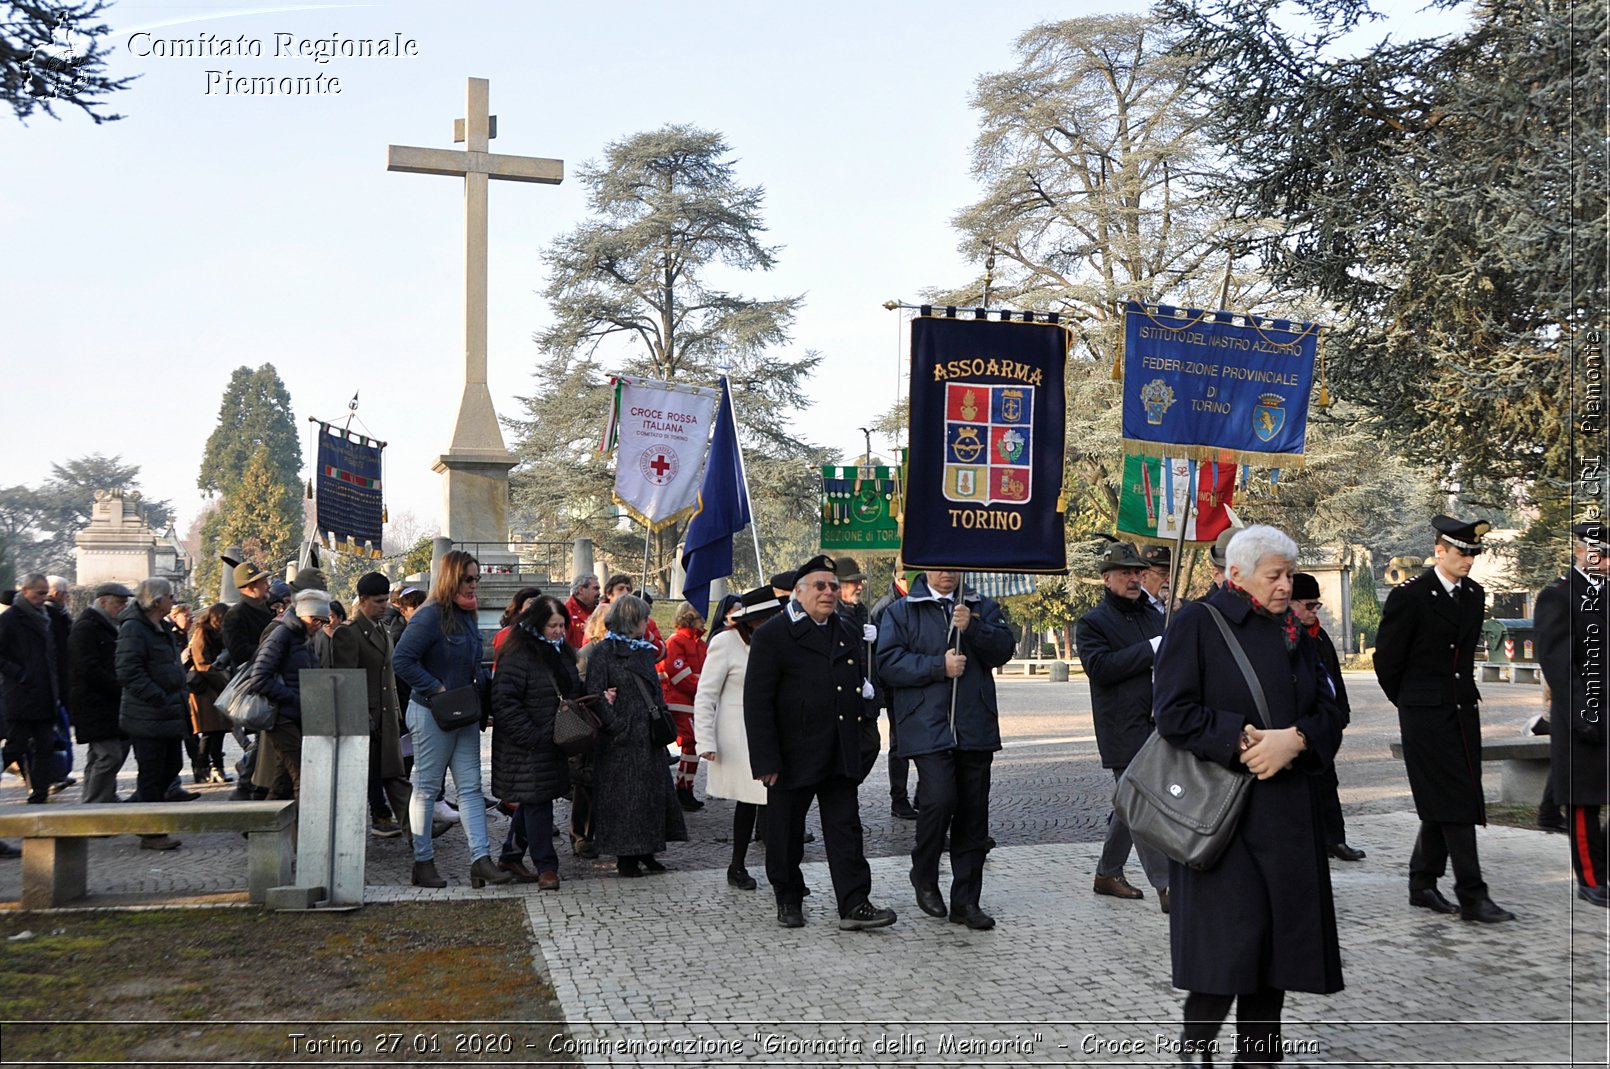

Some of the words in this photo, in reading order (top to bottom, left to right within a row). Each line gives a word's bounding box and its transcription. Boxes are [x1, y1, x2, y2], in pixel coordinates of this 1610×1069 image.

[1139, 327, 1184, 342] ISTITUTO
[1186, 333, 1207, 346] DEL
[1208, 335, 1250, 352] NASTRO
[1252, 341, 1303, 357] AZZURRO
[933, 358, 1043, 386] ASSOARMA
[1142, 357, 1218, 376] FEDERAZIONE
[1222, 365, 1299, 387] PROVINCIALE
[1207, 386, 1217, 398] DI
[630, 407, 663, 420] CROCE
[667, 411, 698, 424] ROSSA
[1191, 400, 1231, 415] TORINO
[642, 420, 684, 433] ITALIANA
[949, 509, 1022, 531] TORINO
